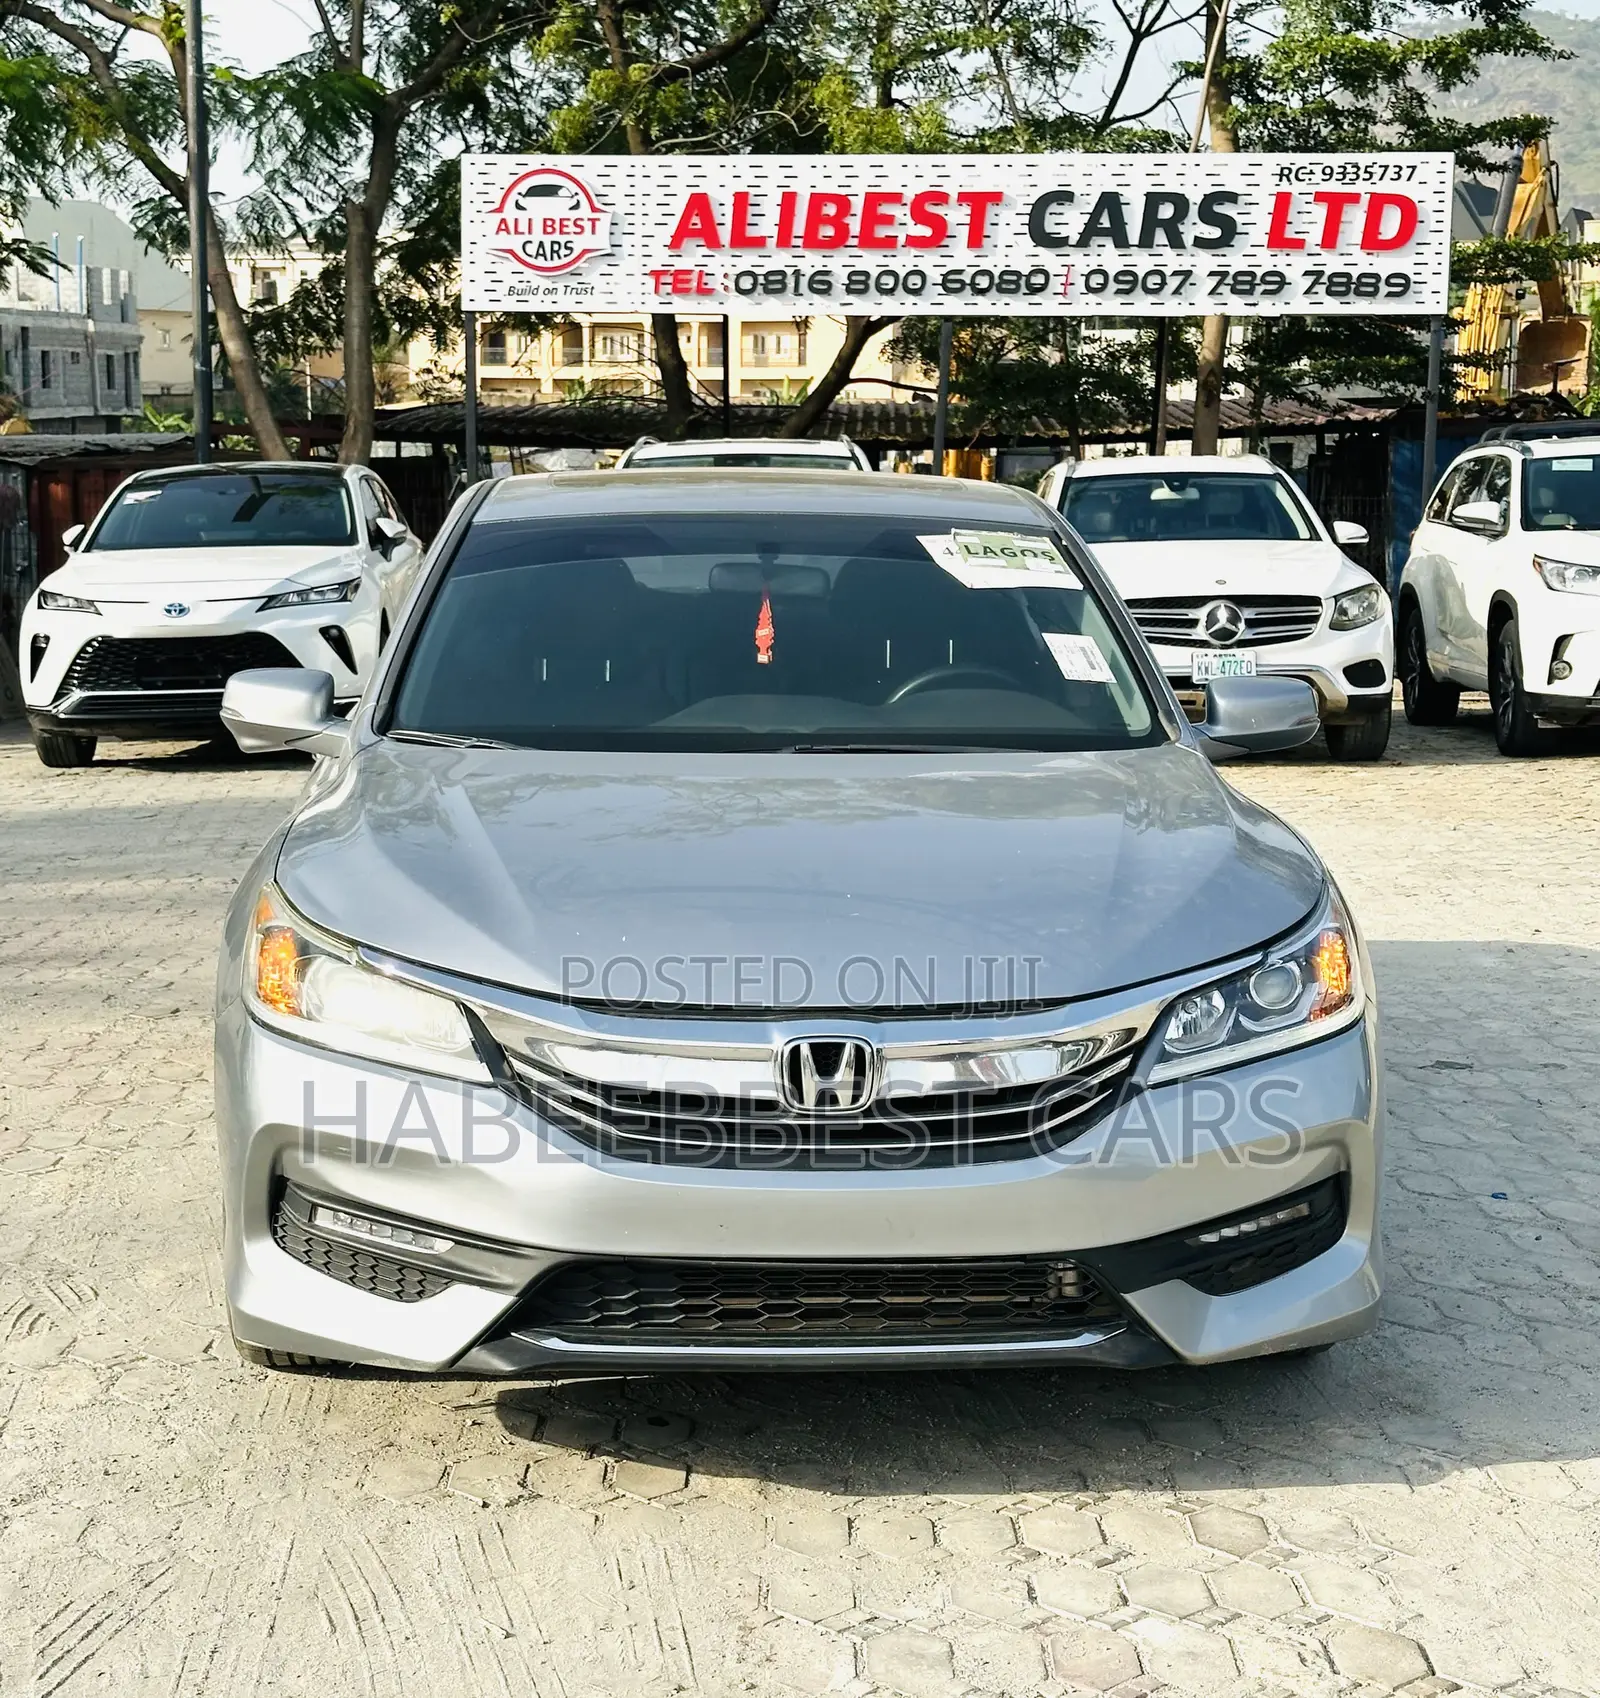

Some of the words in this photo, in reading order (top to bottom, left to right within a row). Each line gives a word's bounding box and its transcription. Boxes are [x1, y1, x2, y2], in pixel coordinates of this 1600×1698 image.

[1321, 165, 1418, 182] 9335737
[495, 217, 534, 236] ALI
[542, 217, 601, 236] BEST
[669, 191, 1003, 250] ALIBEST
[1027, 190, 1239, 249] CARS
[1266, 191, 1419, 251] LTD
[521, 240, 575, 262] CARS
[507, 284, 541, 297] Build
[543, 287, 558, 296] on
[563, 284, 595, 297] Trust
[734, 268, 833, 296] 0816
[845, 269, 927, 296] 800
[941, 268, 1050, 296] 6080
[1084, 268, 1194, 297] 0907
[1207, 270, 1287, 296] 789
[1302, 269, 1412, 298] 7889
[963, 544, 1056, 562] LAGOS
